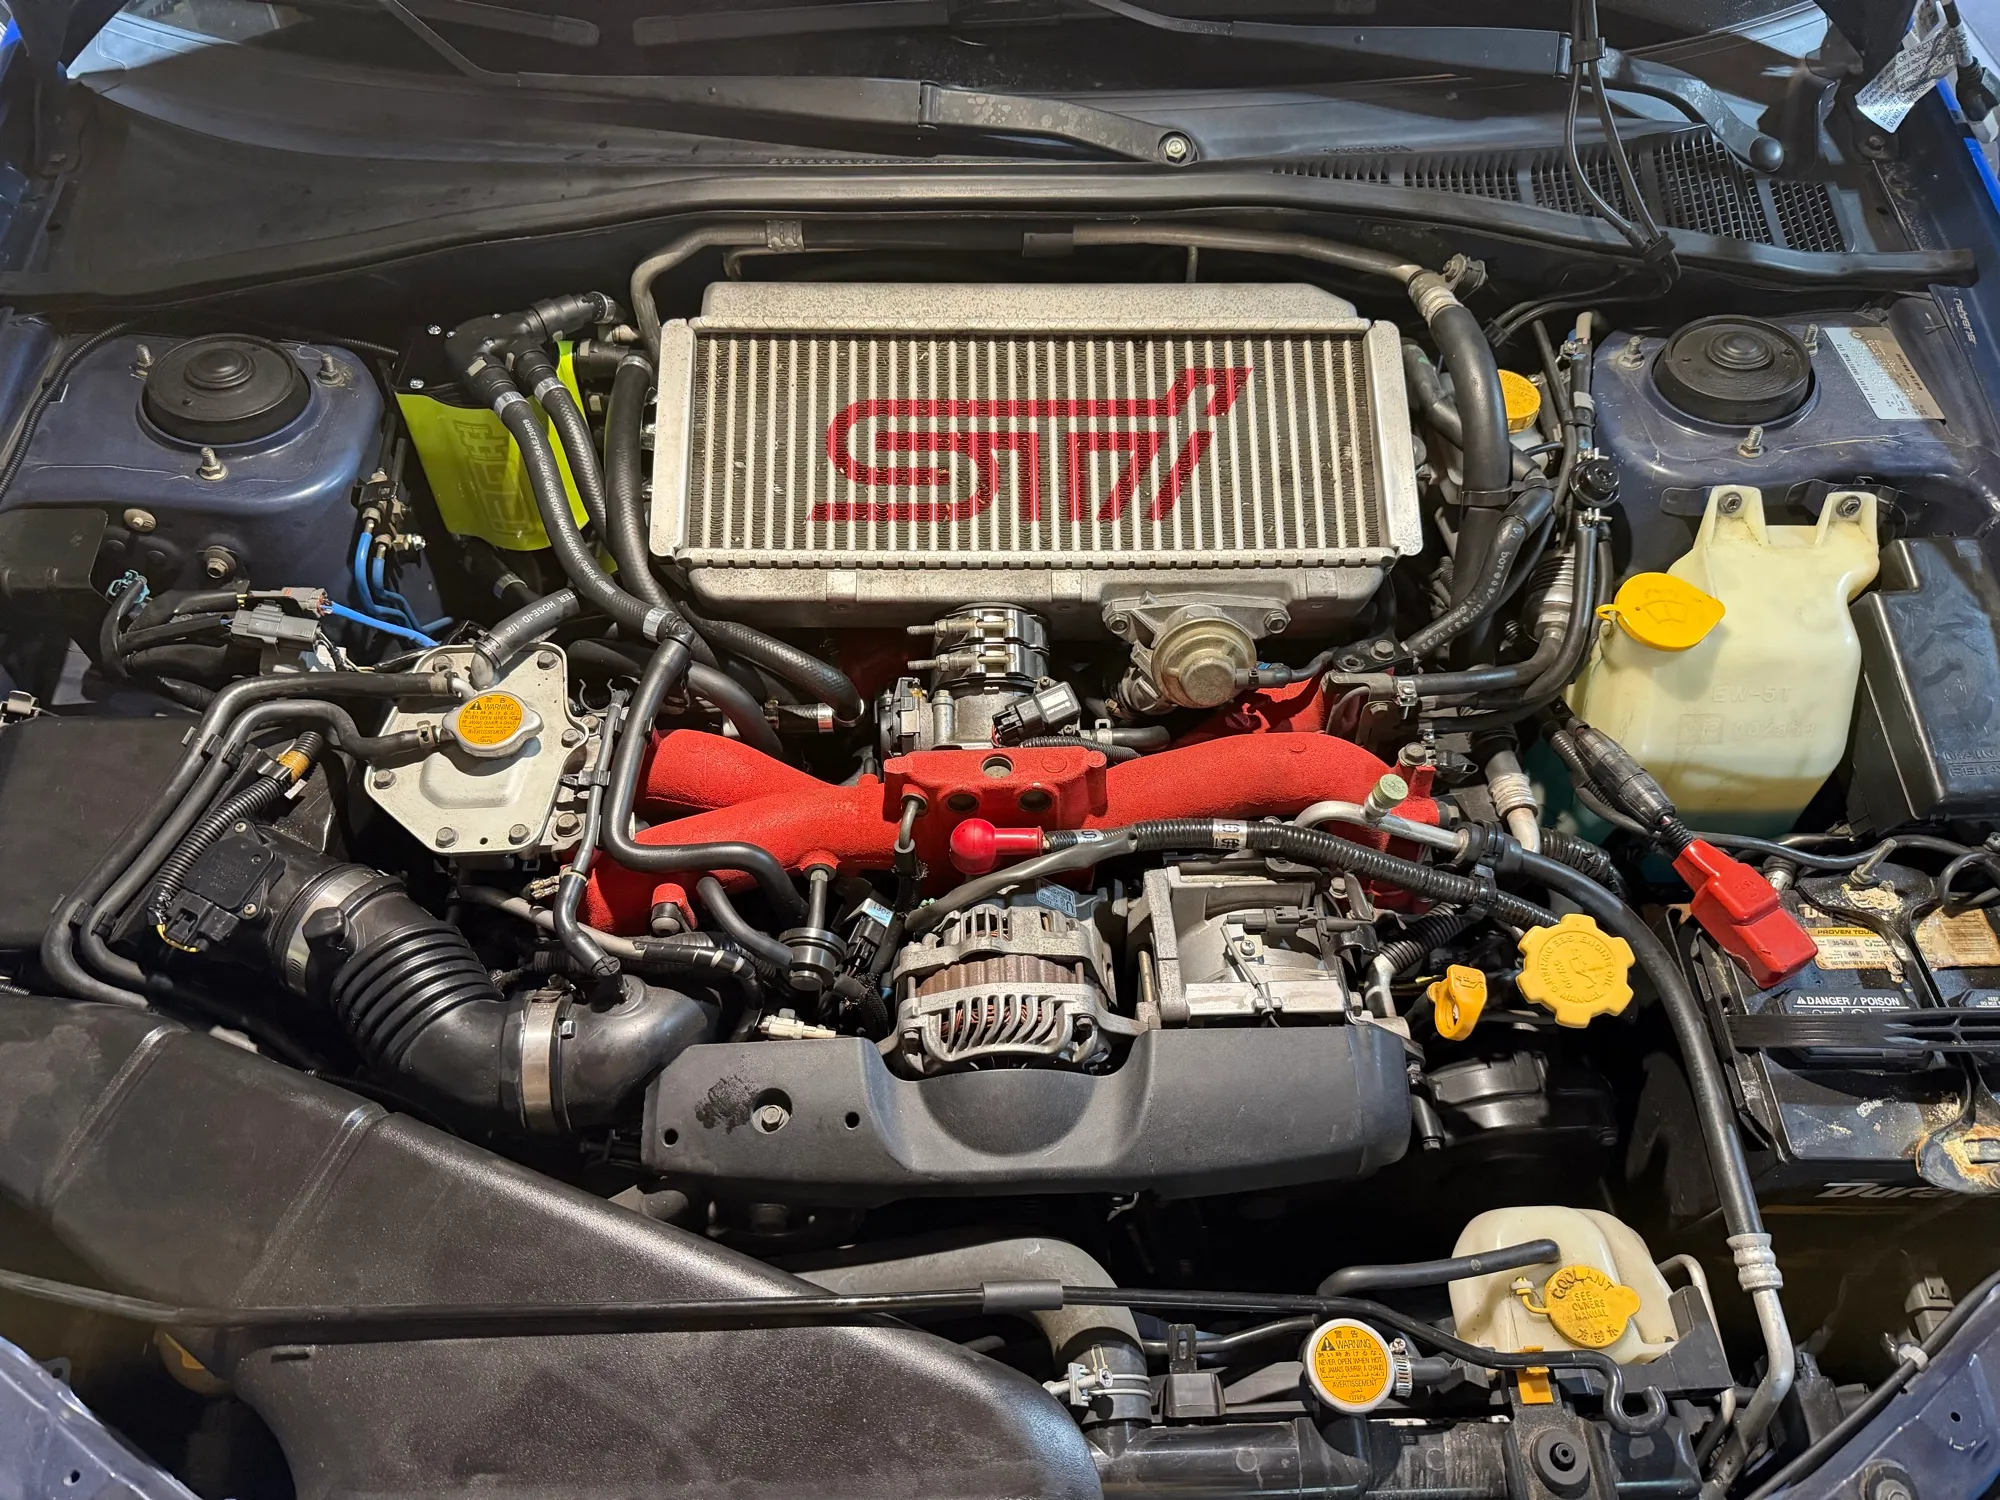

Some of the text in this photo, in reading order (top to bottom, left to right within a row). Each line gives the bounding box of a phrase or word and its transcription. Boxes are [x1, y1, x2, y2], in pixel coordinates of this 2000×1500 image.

[1899, 52, 1909, 63] OF
[521, 599, 554, 623] HOSE-ID
[1712, 685, 1793, 703] EW-5T
[1559, 991, 1605, 1004] MANUAL
[1807, 996, 1850, 1006] DANGER
[1860, 997, 1900, 1006] POISON
[1551, 1267, 1615, 1300] COOLANT
[1574, 1290, 1593, 1302] SEE
[1571, 1299, 1606, 1312] OWNERS
[1574, 1308, 1609, 1321] MANUAL
[1335, 1338, 1372, 1349] WARNING
[1318, 1358, 1336, 1366] NEVER
[1332, 1379, 1377, 1388] AVERTISSEMENT
